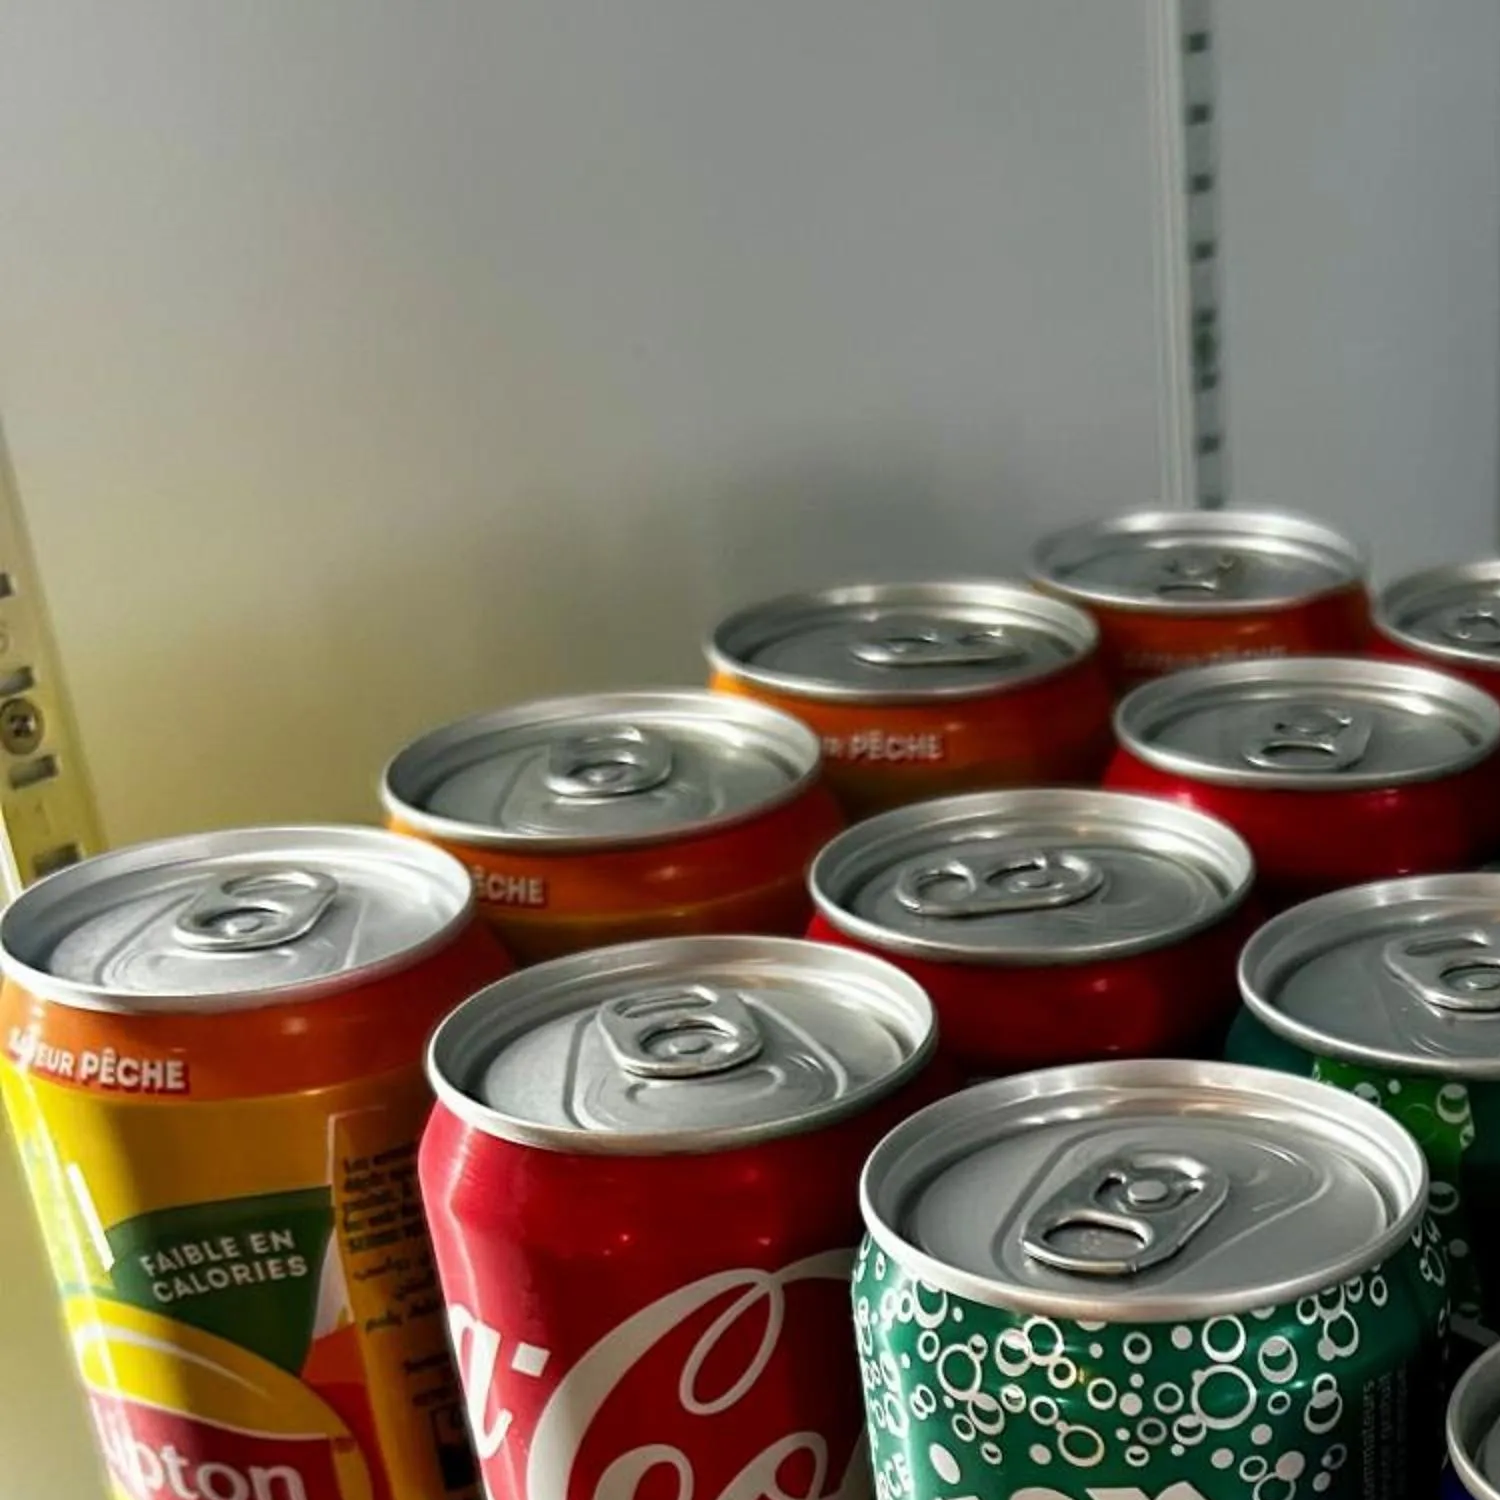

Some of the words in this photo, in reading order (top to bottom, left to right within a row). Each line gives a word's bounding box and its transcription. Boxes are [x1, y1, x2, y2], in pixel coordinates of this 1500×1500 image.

[79, 1047, 185, 1089] PÊCHE
[139, 1236, 241, 1277] FAIBLE
[250, 1229, 296, 1254] EN
[152, 1255, 308, 1302] CALORIES
